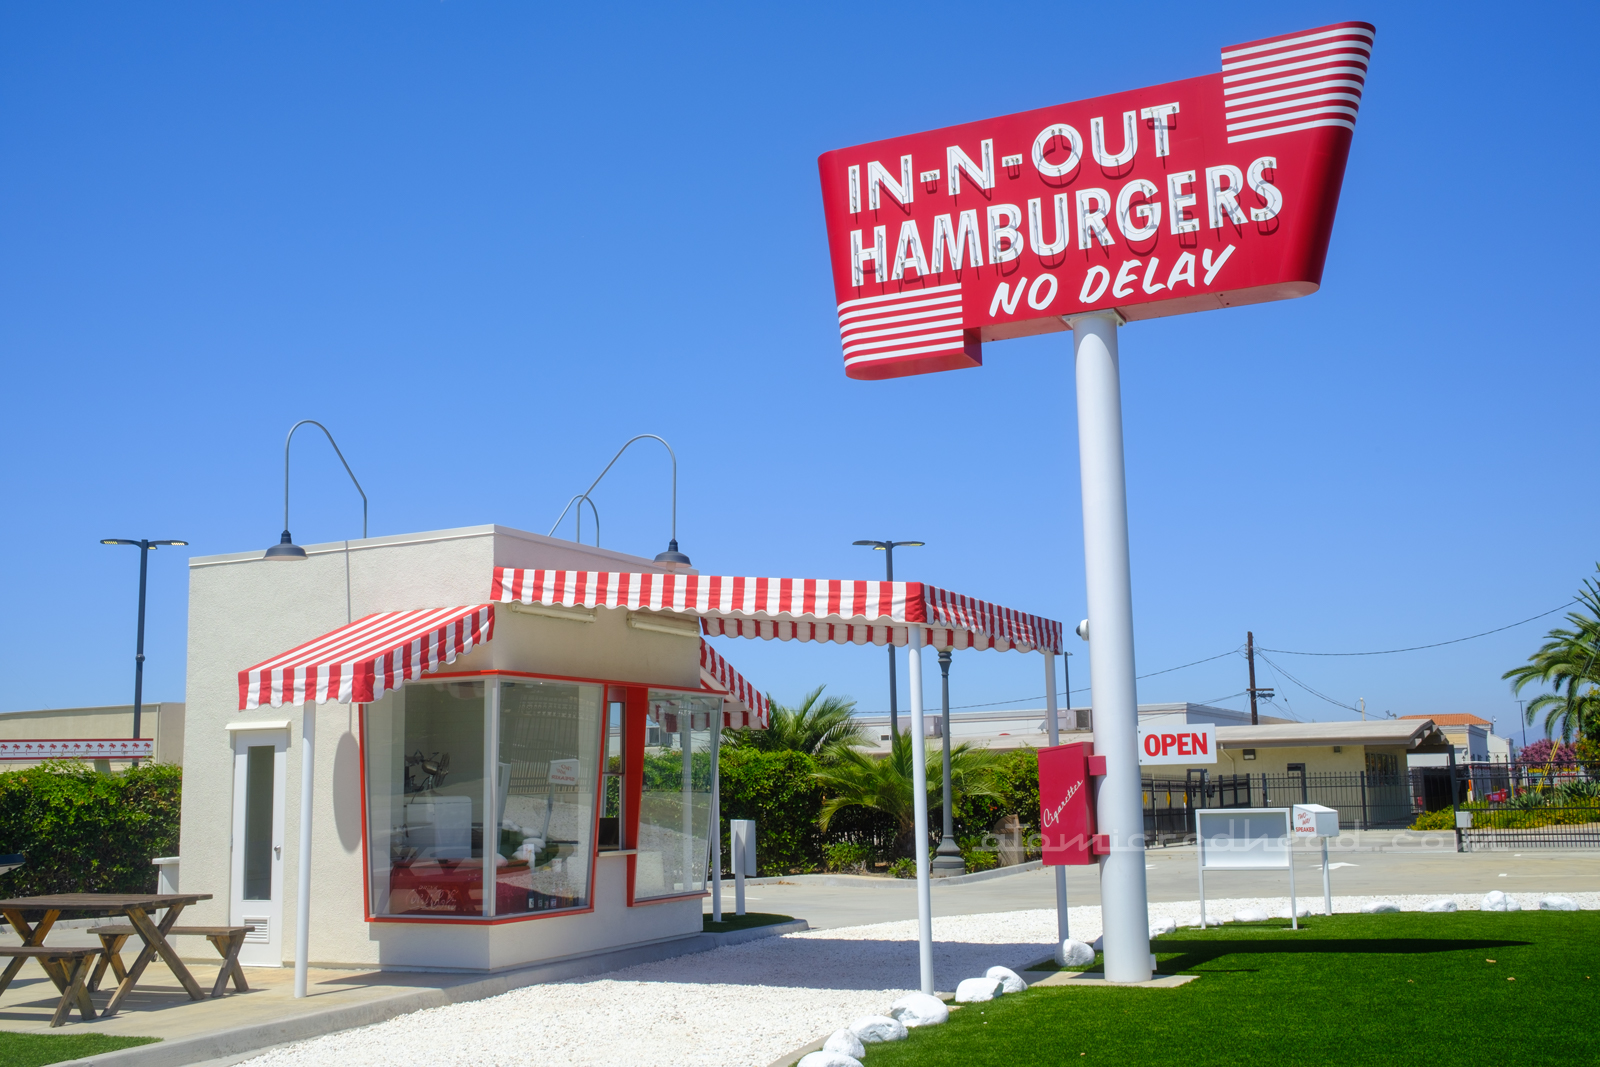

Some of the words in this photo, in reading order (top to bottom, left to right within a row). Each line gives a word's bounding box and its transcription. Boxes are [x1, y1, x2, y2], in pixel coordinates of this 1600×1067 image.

[848, 102, 1180, 214] IN-N-OUT
[850, 156, 1283, 287] HAMBURGERS
[988, 273, 1058, 318] NO
[1079, 244, 1236, 304] DELAY
[1144, 732, 1208, 757] OPEN
[1043, 779, 1084, 828] Cigarettes
[1302, 817, 1311, 825] WAY
